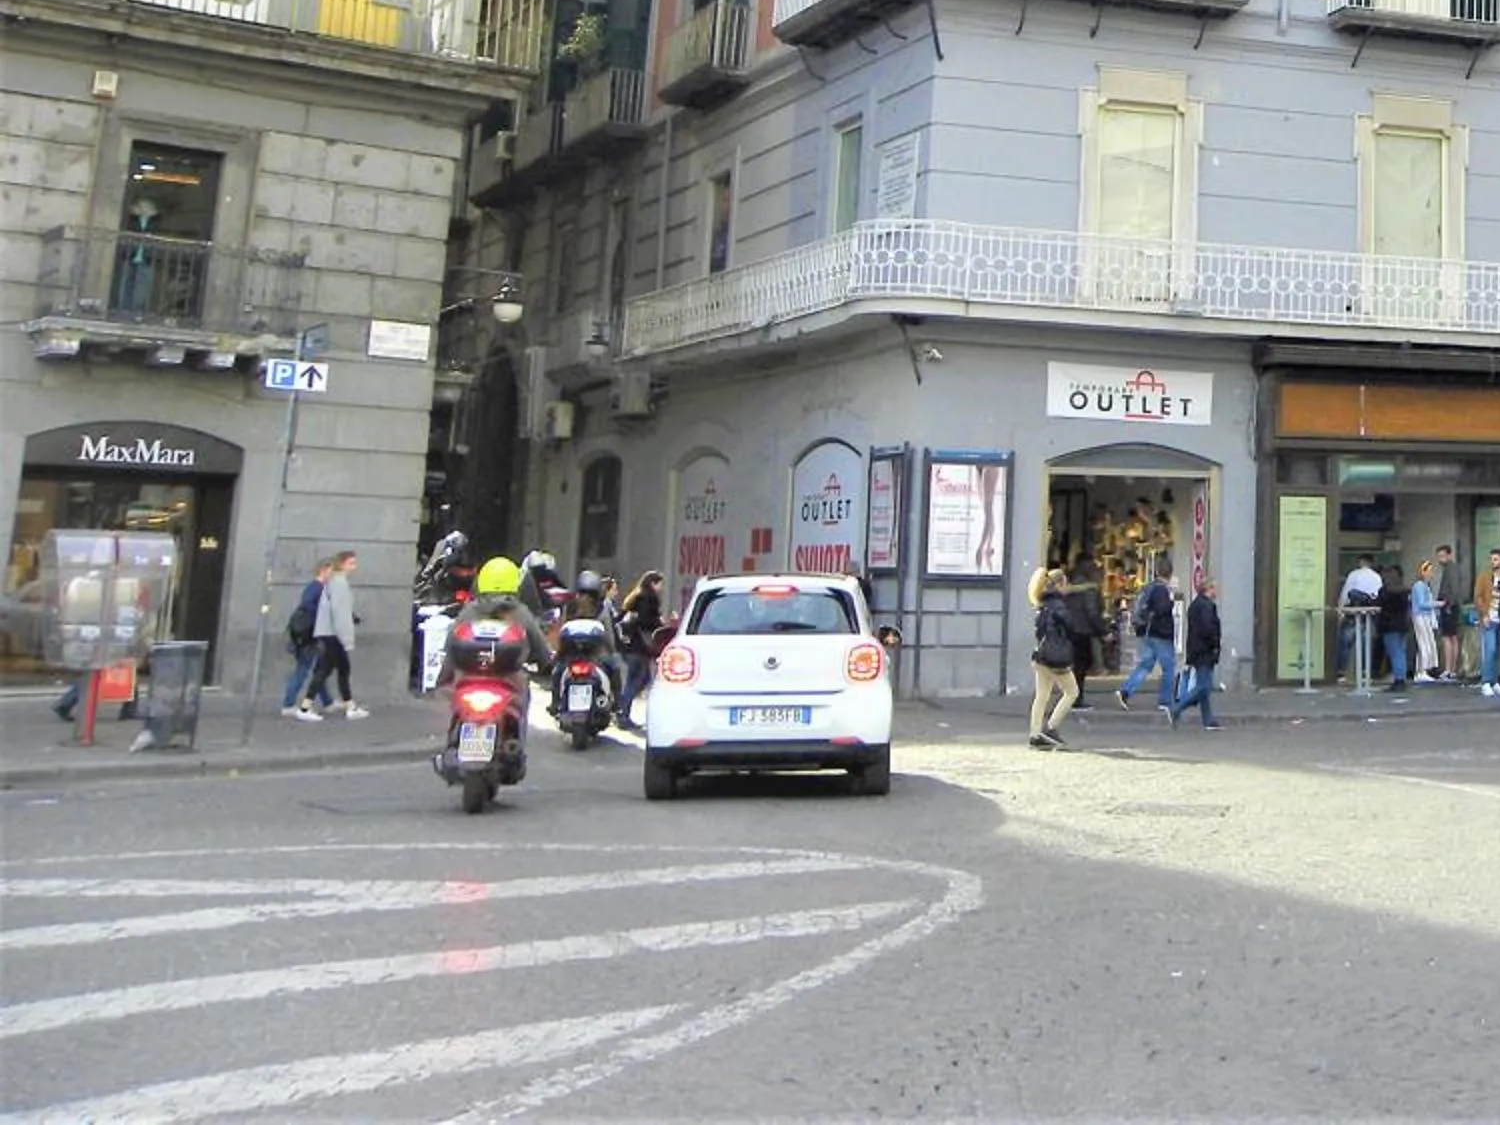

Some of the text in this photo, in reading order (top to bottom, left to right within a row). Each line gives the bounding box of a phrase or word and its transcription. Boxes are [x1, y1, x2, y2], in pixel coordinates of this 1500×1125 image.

[276, 364, 292, 384] P
[1069, 381, 1134, 394] TEMPORARY
[1069, 391, 1193, 416] OUTLET
[78, 435, 195, 465] MaxMara
[684, 499, 727, 522] OUTLET
[801, 499, 852, 523] OUTLET
[680, 535, 726, 575] SVUOTA
